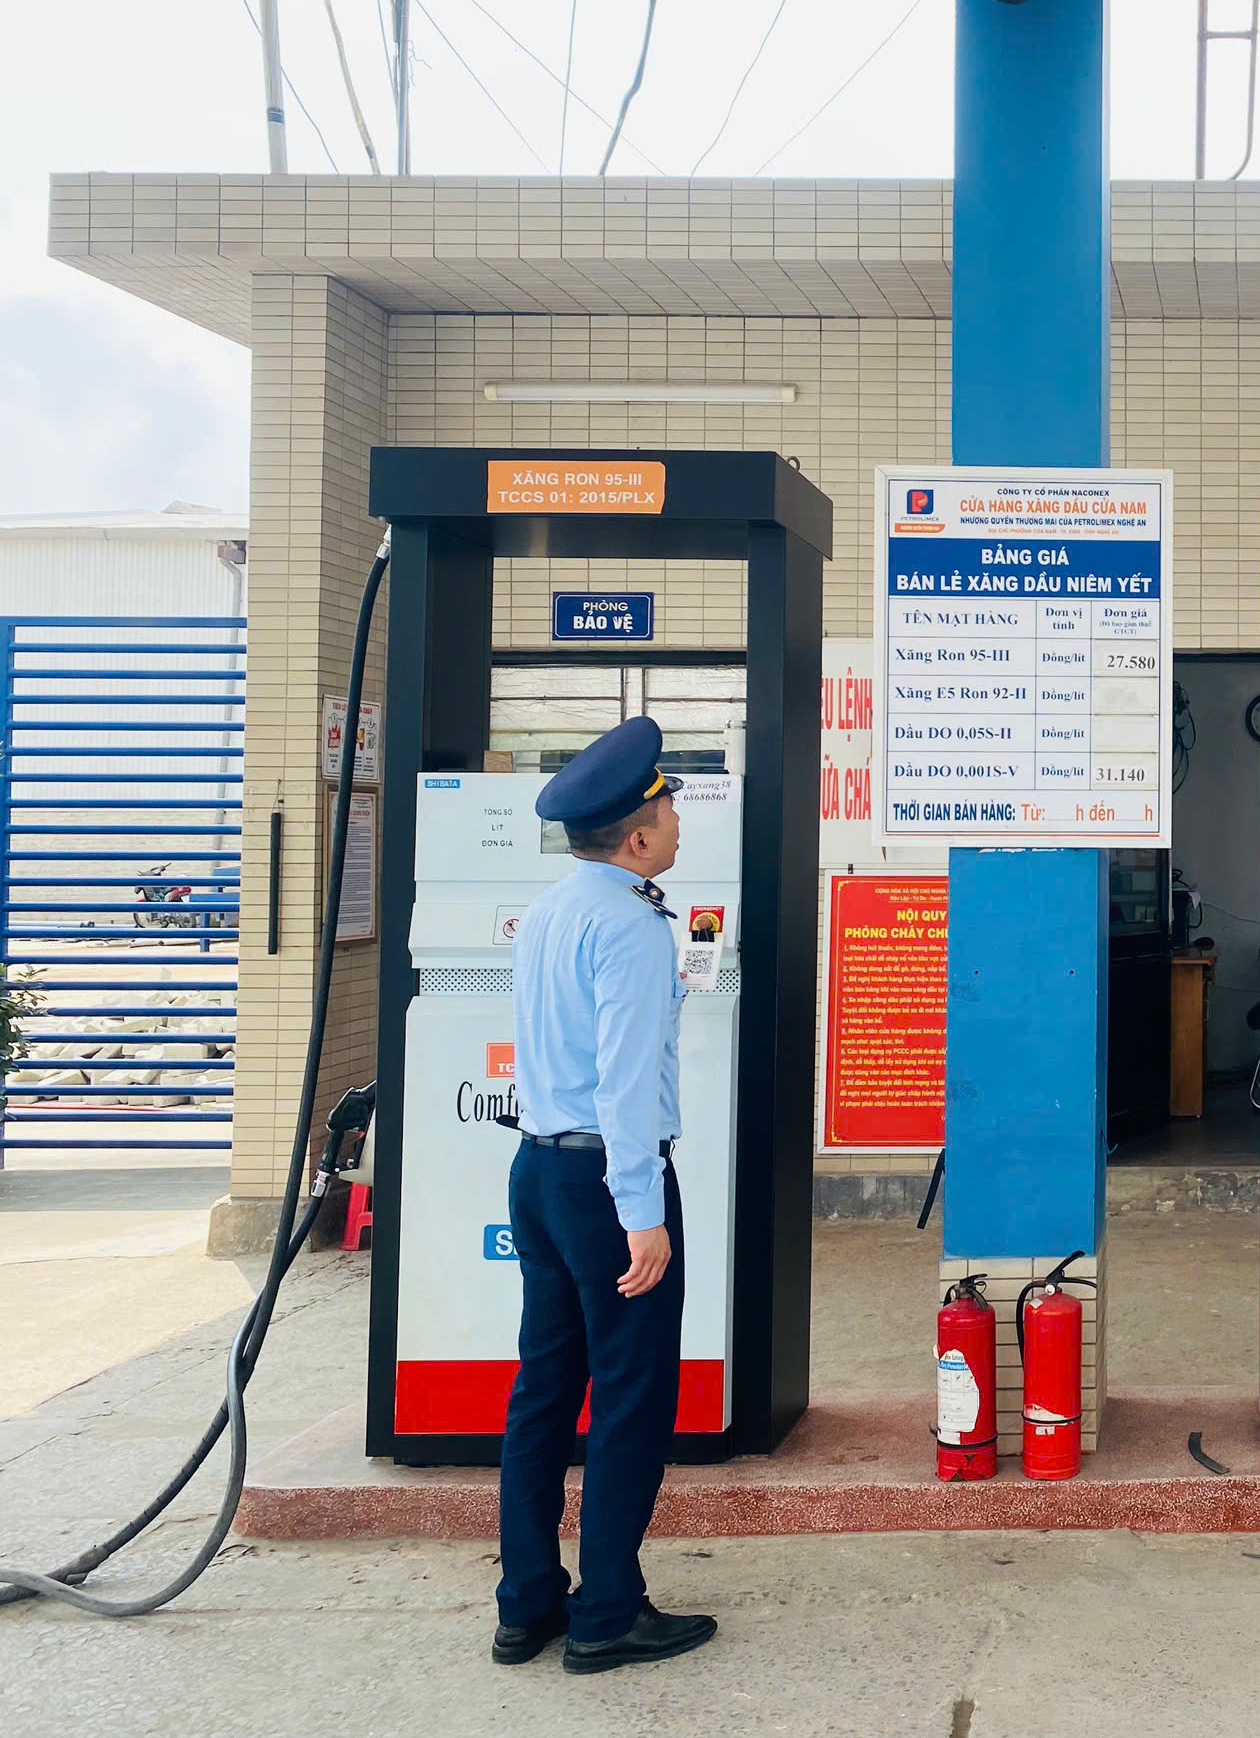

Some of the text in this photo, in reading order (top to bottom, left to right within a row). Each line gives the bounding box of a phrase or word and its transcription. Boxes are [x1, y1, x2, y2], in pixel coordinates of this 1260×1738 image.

[512, 470, 642, 485] XĂNG RON 95-III
[498, 491, 655, 504] TCCS 01: 2015/PLX
[1071, 489, 1110, 497] NACONEX
[960, 495, 1146, 514] CỬA HÀNG XĂNG DẦU CỬA NAM
[1074, 518, 1115, 526] PETROLIMEX
[981, 543, 1070, 566] BẢNG GIÁ
[896, 570, 1152, 594] BÁN LẺ XĂNG DẦU NIÊM YẾT
[583, 599, 629, 612] PHÒNG
[903, 609, 1018, 627] TÊN MẶT HÀNG
[1045, 607, 1082, 619] Đơn vị
[1104, 608, 1147, 620] Đơn giá
[573, 610, 633, 633] BẢO VỆ
[1052, 621, 1075, 630] tính
[895, 649, 1010, 663] Xăng Ron 95-III
[1042, 651, 1085, 664] Đồng/lít
[1107, 655, 1156, 670] 27.580
[895, 686, 1027, 702] Xăng E5 Ron 92-II
[1042, 688, 1085, 702] Đồng/lít
[895, 723, 1012, 741] Dầu DO 0,05S-II
[1042, 726, 1085, 740] Đồng/lít
[894, 761, 1019, 779] Dầu DO 0,001S-V
[1041, 764, 1084, 778] Đồng/lít
[1096, 768, 1145, 782] 31.140
[426, 780, 459, 788] SHIBATA
[844, 756, 871, 821] CHÁ
[893, 799, 920, 821] THỜI
[923, 804, 952, 821] GIAN
[955, 799, 978, 821] BÁN
[981, 799, 1016, 821] HÀNG:
[1089, 799, 1115, 822] đến
[896, 908, 947, 924] NỘI QUY
[844, 925, 925, 939] PHÒNG CHÁY
